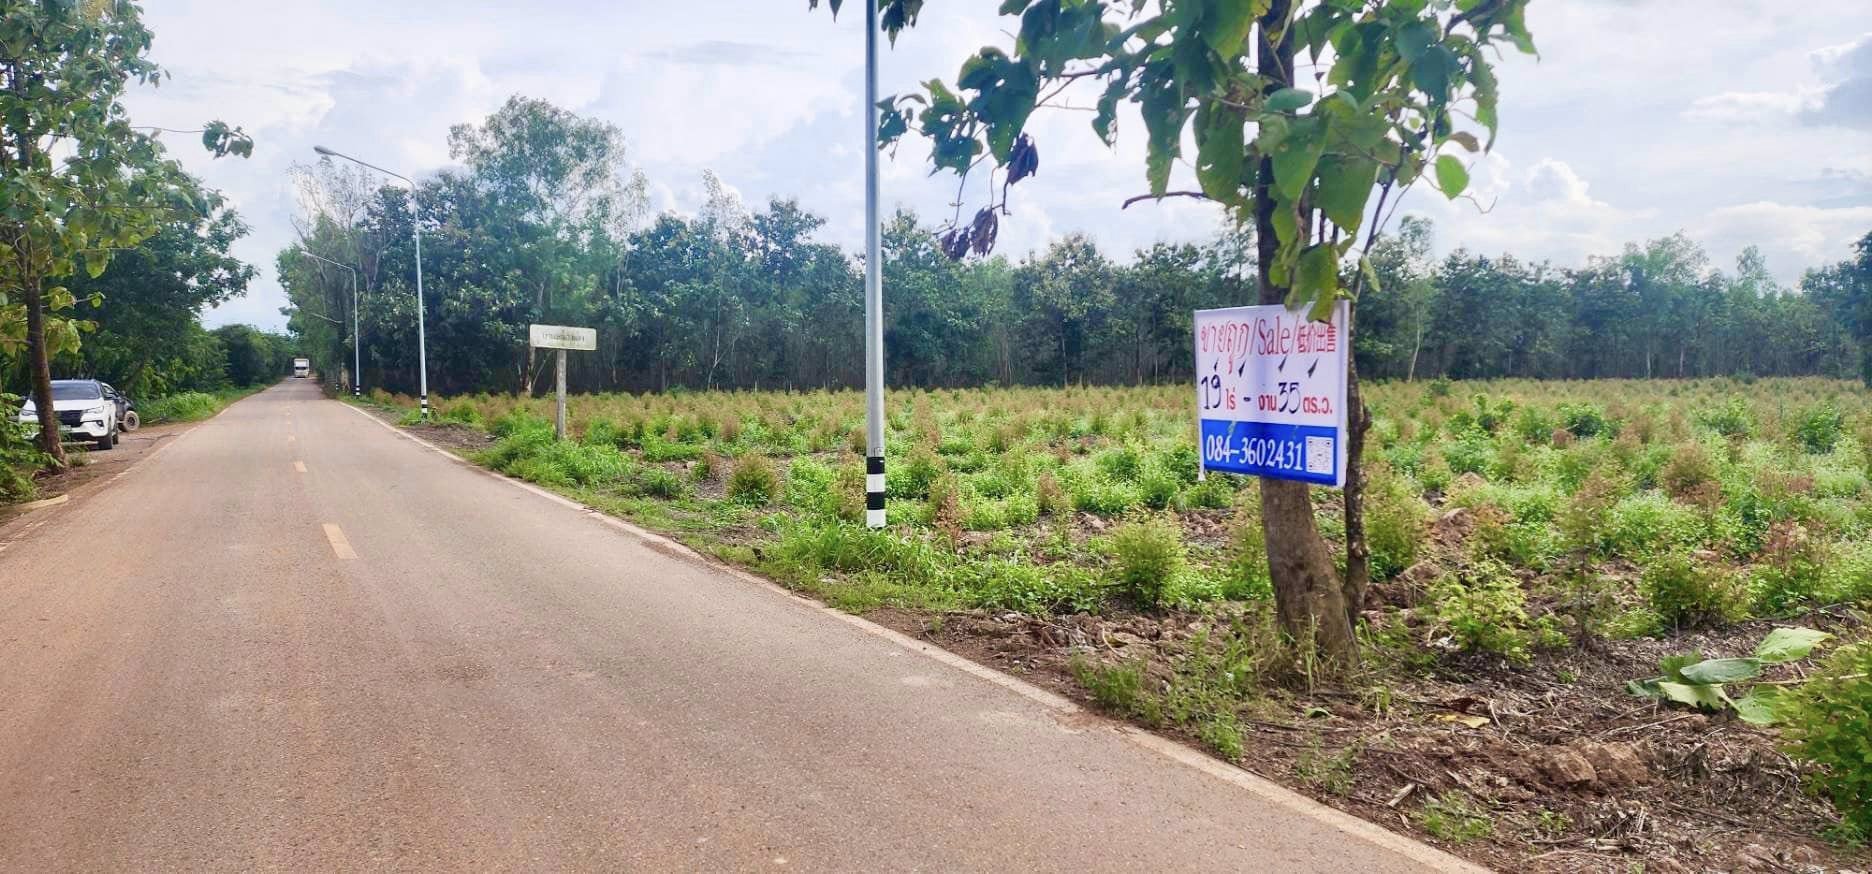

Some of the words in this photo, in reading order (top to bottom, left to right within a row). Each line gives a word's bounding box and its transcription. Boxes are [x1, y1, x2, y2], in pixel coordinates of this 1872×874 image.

[1201, 374, 1221, 410] 19
[1225, 387, 1236, 410] ไร่
[1258, 394, 1277, 411] งาน
[1278, 382, 1301, 414] 35
[1303, 396, 1333, 414] ตร.ว.
[1206, 434, 1304, 471] 084-3602431
